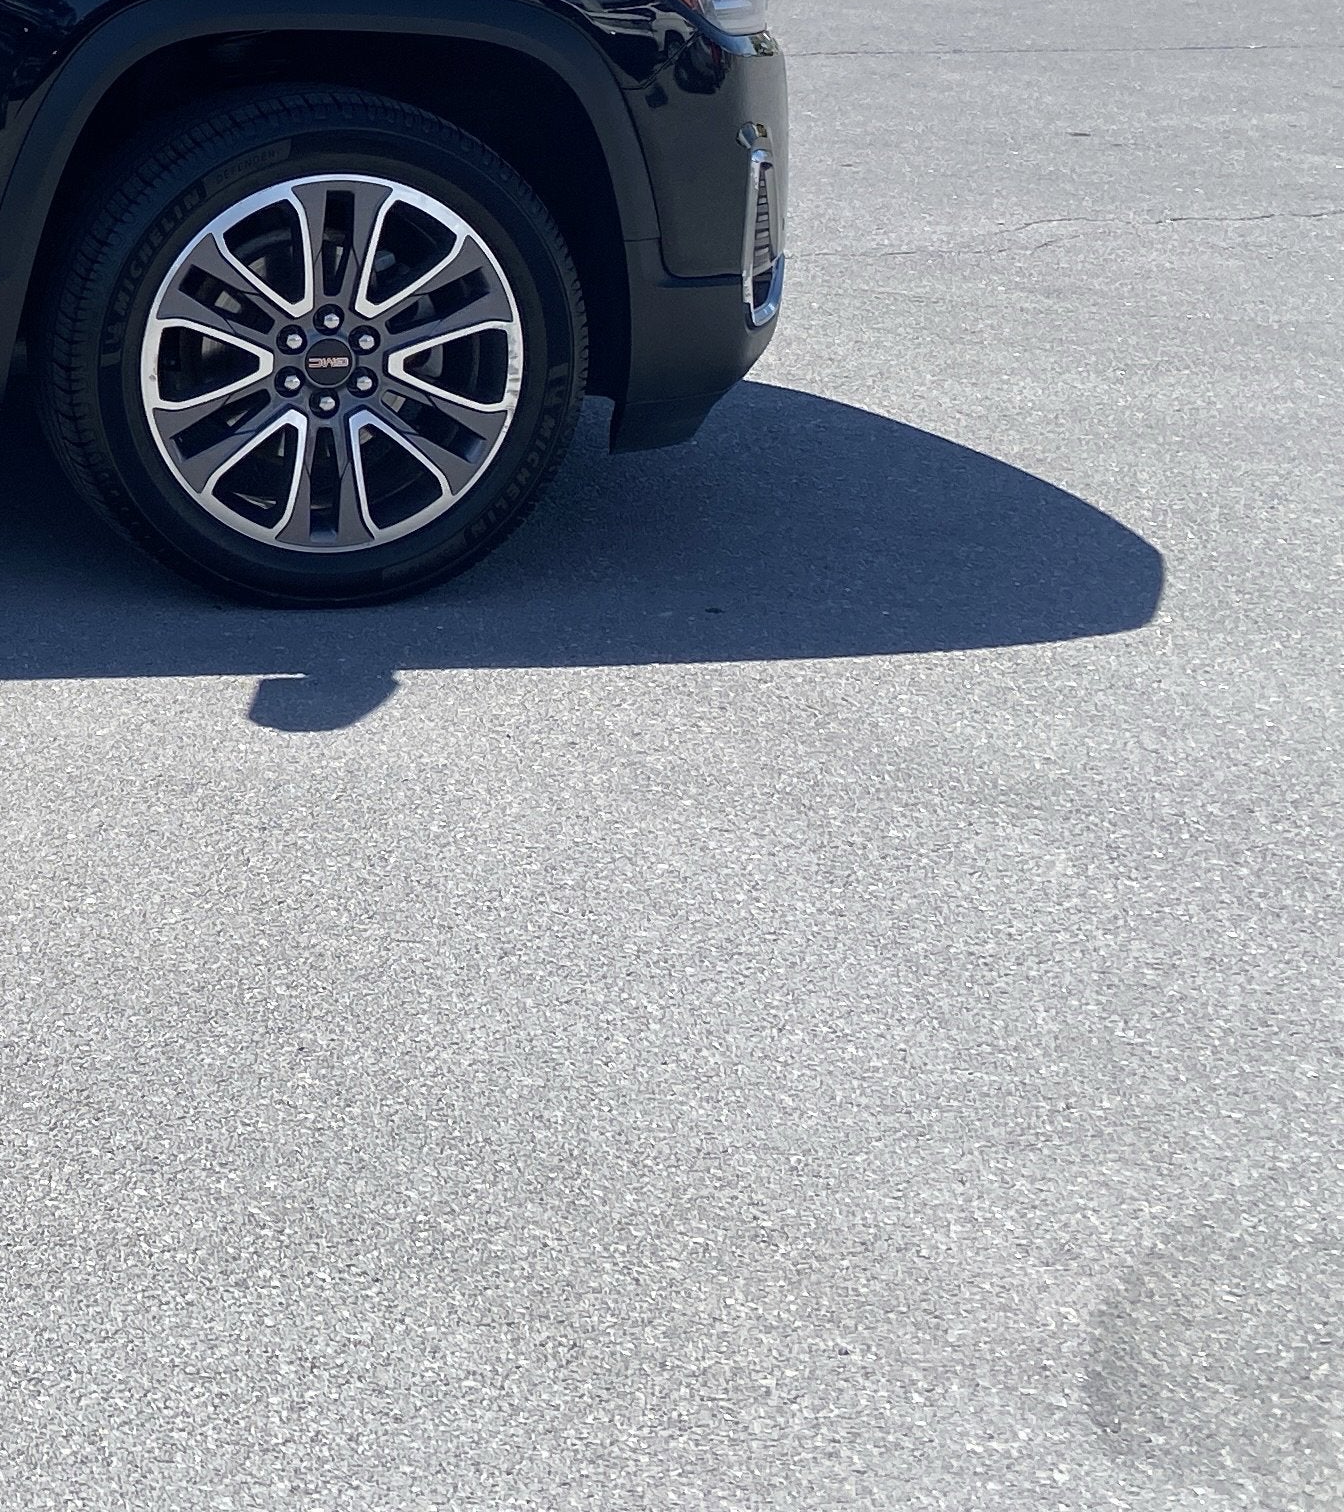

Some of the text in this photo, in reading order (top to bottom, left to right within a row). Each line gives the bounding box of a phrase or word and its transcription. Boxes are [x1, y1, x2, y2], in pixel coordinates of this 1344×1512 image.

[112, 186, 207, 316] MICHELIN
[308, 357, 349, 368] GMC
[469, 413, 556, 540] MICHELIN
